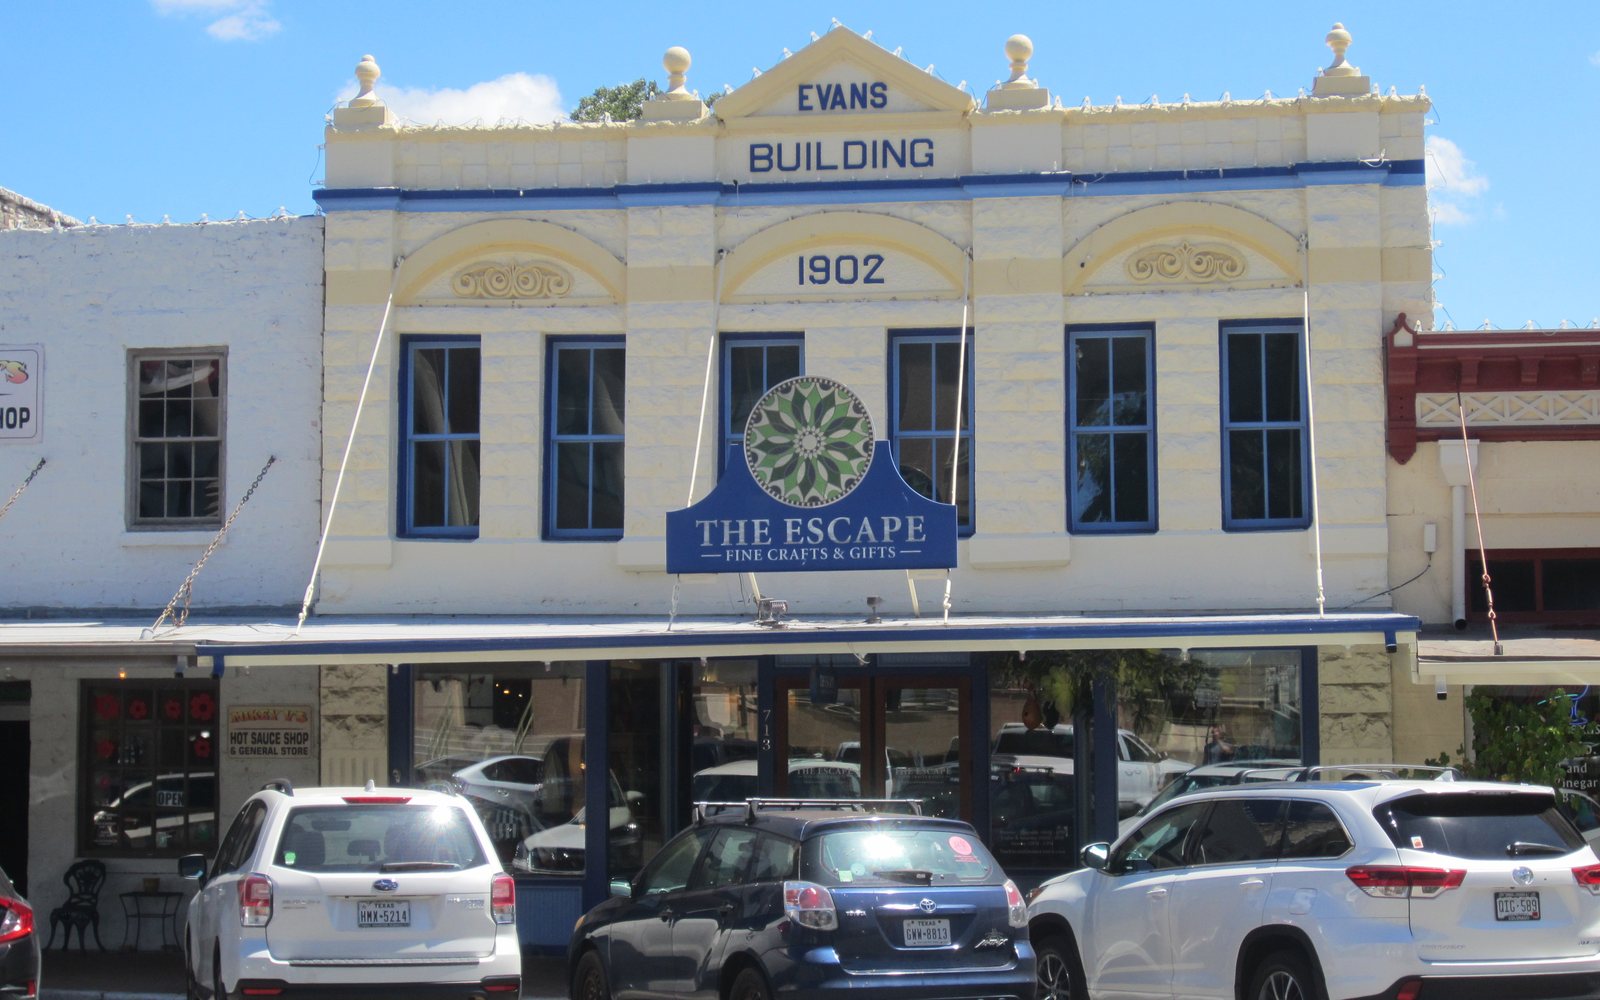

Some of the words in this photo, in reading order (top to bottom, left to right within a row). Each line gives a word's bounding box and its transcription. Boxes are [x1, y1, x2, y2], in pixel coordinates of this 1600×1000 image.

[798, 82, 888, 111] EVANS
[750, 138, 934, 172] BUILDING
[798, 254, 885, 285] 1902
[696, 519, 772, 547] THE
[784, 515, 927, 545] ESCAPE
[726, 550, 762, 561] FINE
[767, 548, 828, 561] CRAFTS
[833, 548, 845, 560] &
[850, 546, 896, 560] GIFTS
[762, 709, 771, 750] 713
[230, 731, 248, 745] HOT
[251, 731, 281, 745] SAUCE
[283, 731, 309, 745] SHOP
[230, 747, 236, 755] &
[239, 746, 278, 755] GENERAL
[281, 746, 309, 755] STORE
[1567, 762, 1588, 774] and
[1558, 778, 1599, 789] inegar
[158, 791, 184, 805] OPEN
